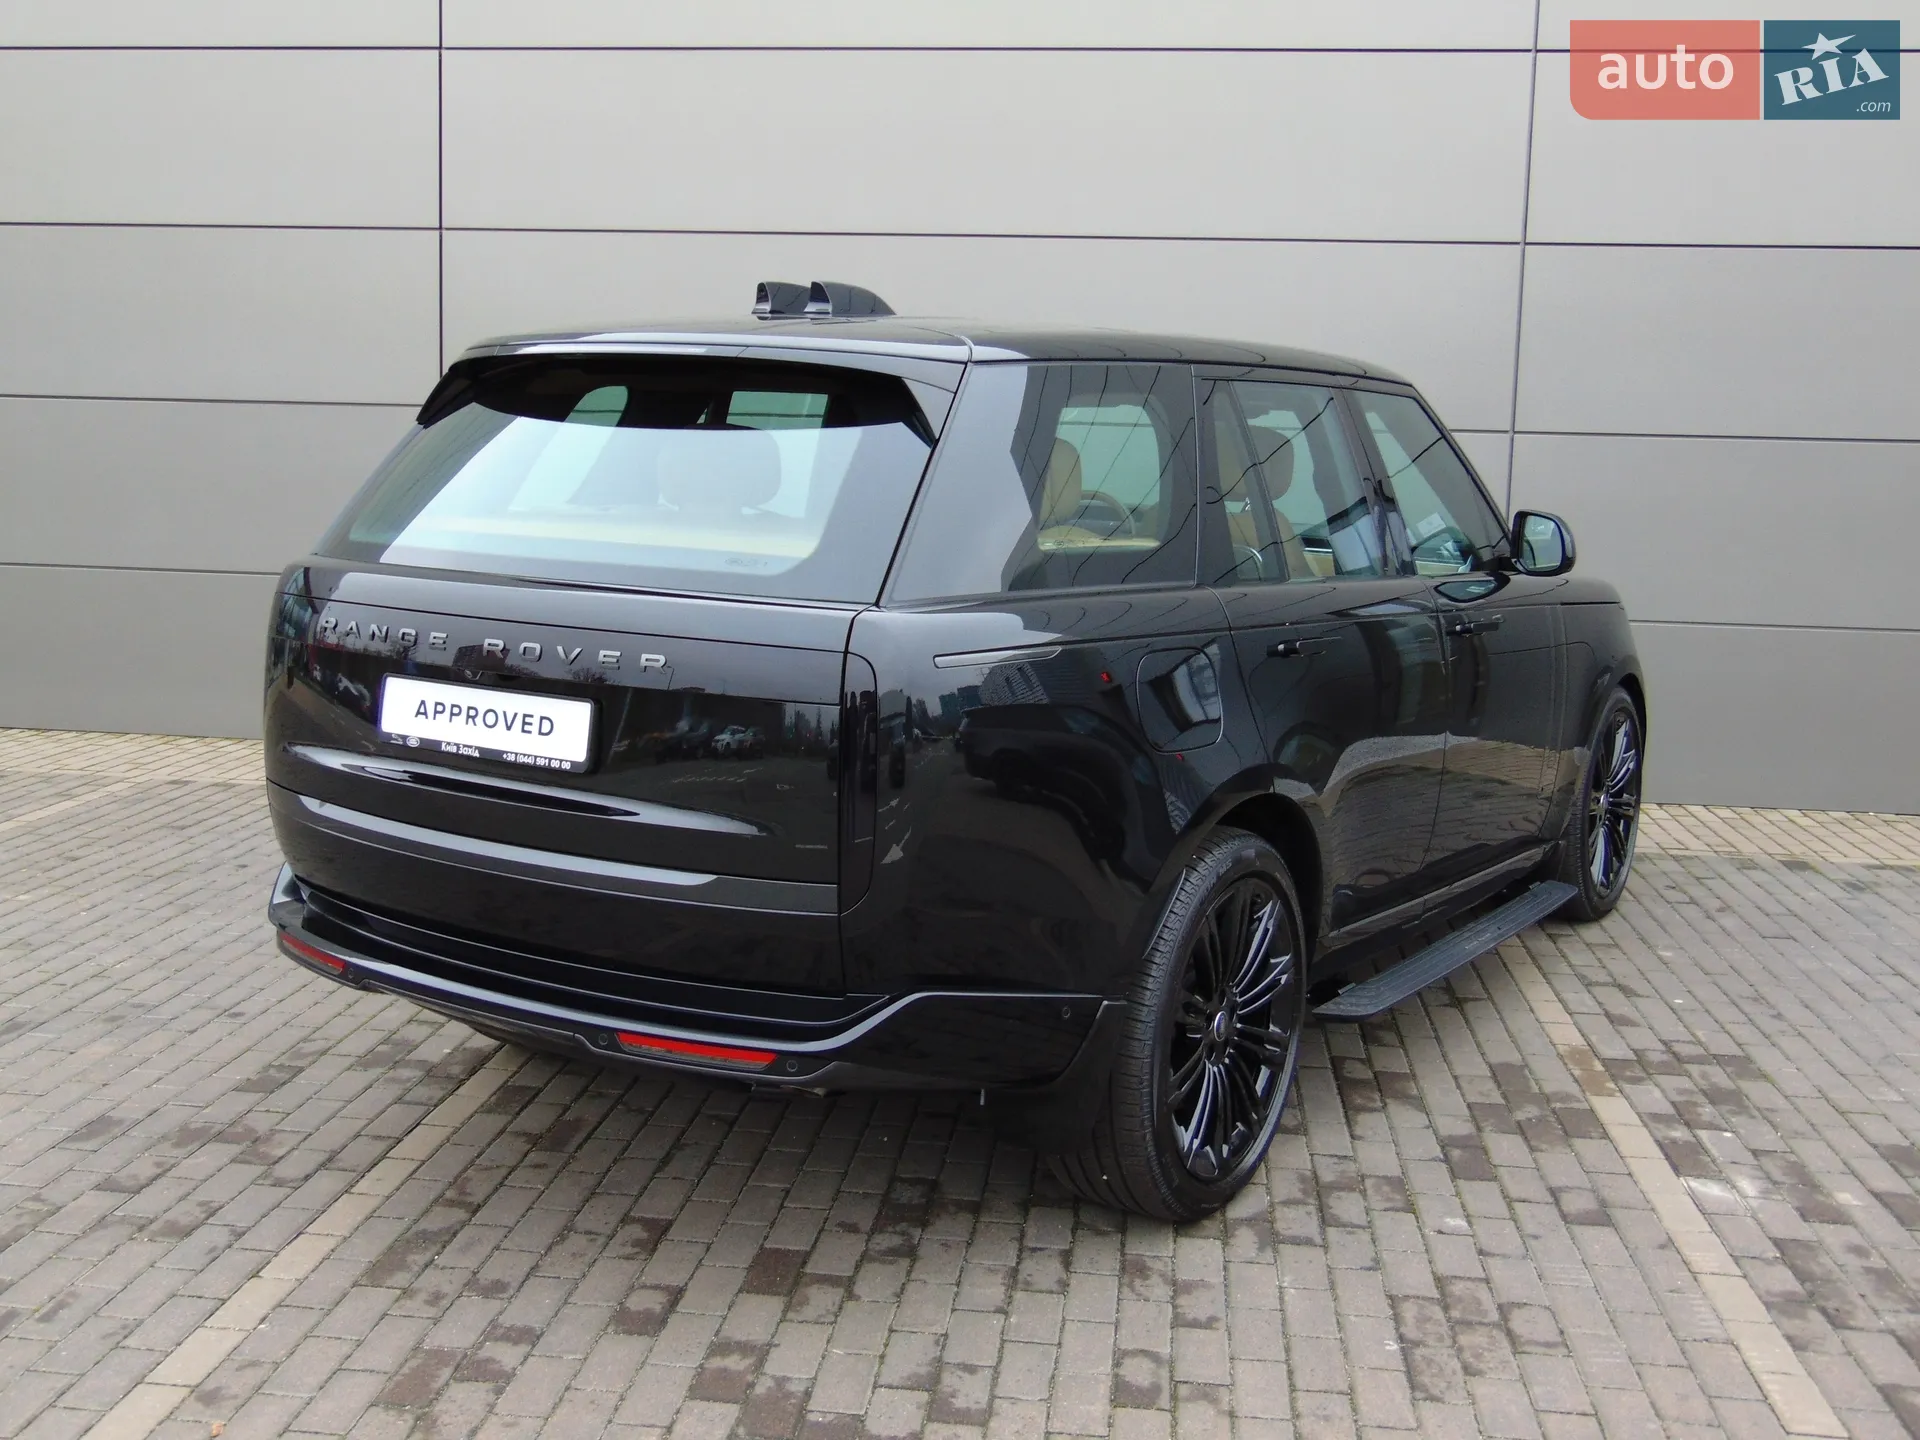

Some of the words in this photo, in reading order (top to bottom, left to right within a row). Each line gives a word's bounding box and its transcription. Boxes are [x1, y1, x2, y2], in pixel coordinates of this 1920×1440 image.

[319, 617, 449, 651] RANGE
[483, 638, 668, 674] ROVER
[414, 699, 554, 737] APPROVED
[441, 742, 457, 753] Київ
[458, 745, 480, 757] Захід
[502, 753, 515, 761] +38
[516, 754, 535, 765] (044)
[536, 758, 549, 766] 591
[550, 760, 560, 768] 00
[561, 761, 571, 770] 00
